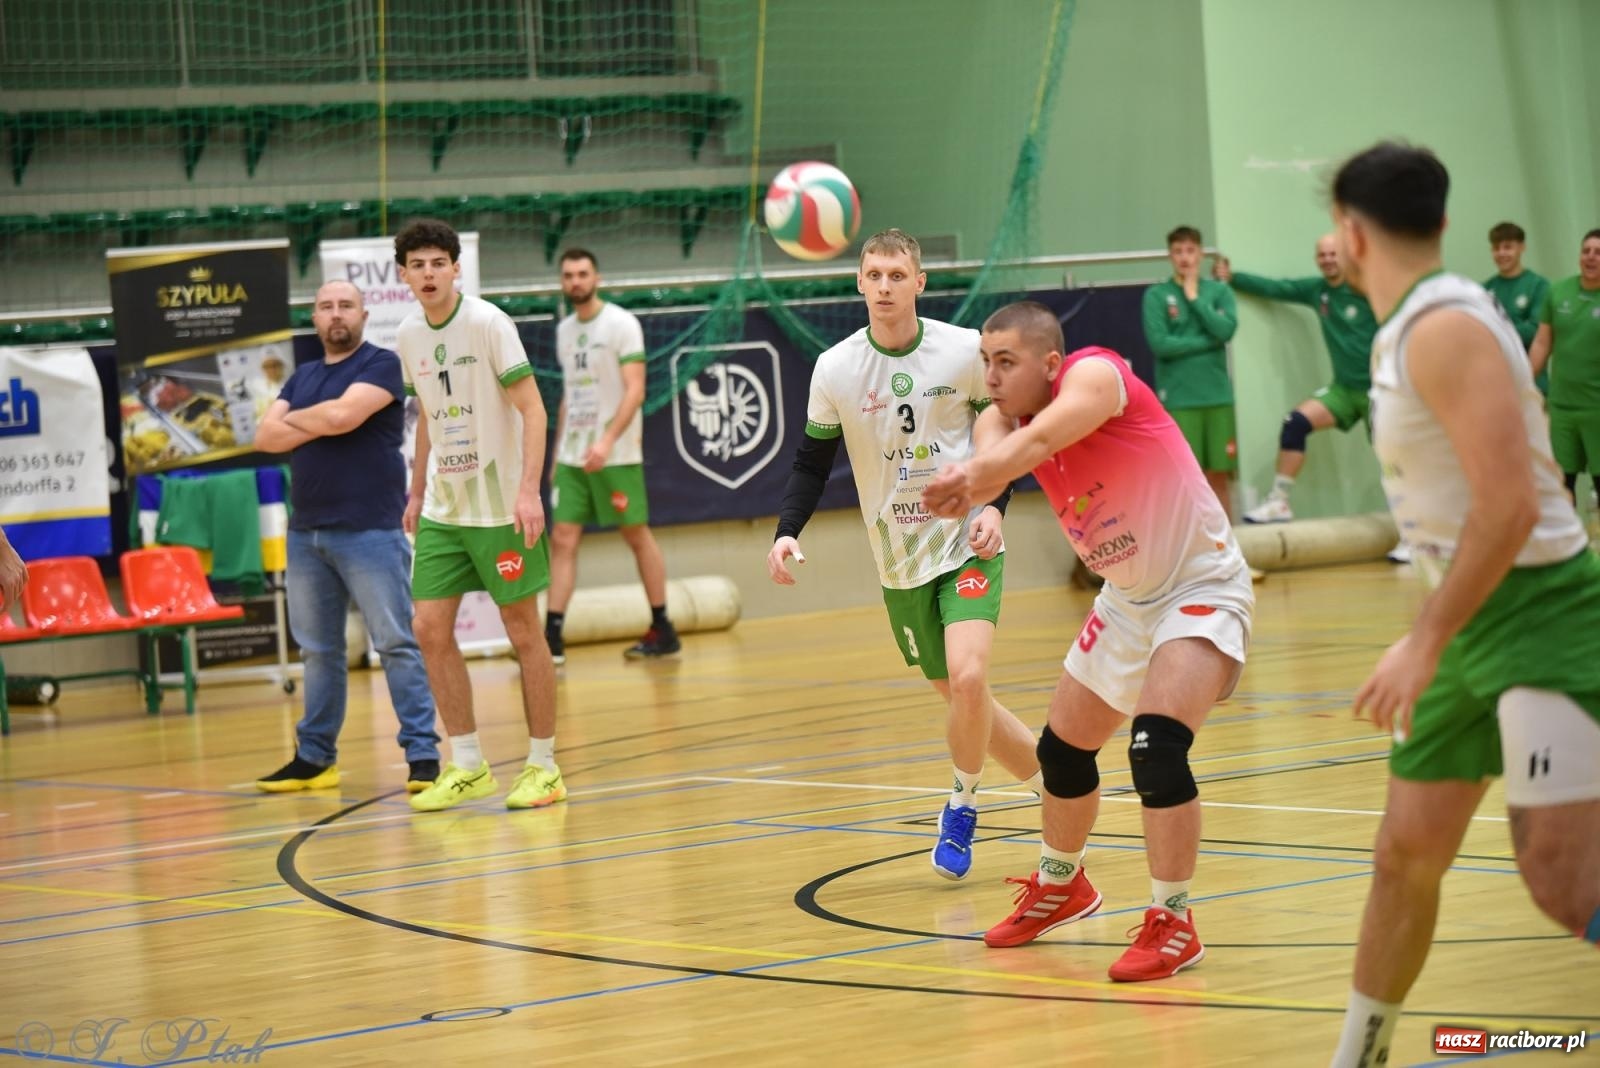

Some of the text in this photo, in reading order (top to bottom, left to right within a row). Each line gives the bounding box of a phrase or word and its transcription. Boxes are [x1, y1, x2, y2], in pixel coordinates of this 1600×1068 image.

[897, 403, 916, 435] 3
[882, 441, 941, 461] VISON
[0, 476, 62, 497] ndorffa
[903, 625, 920, 659] 3
